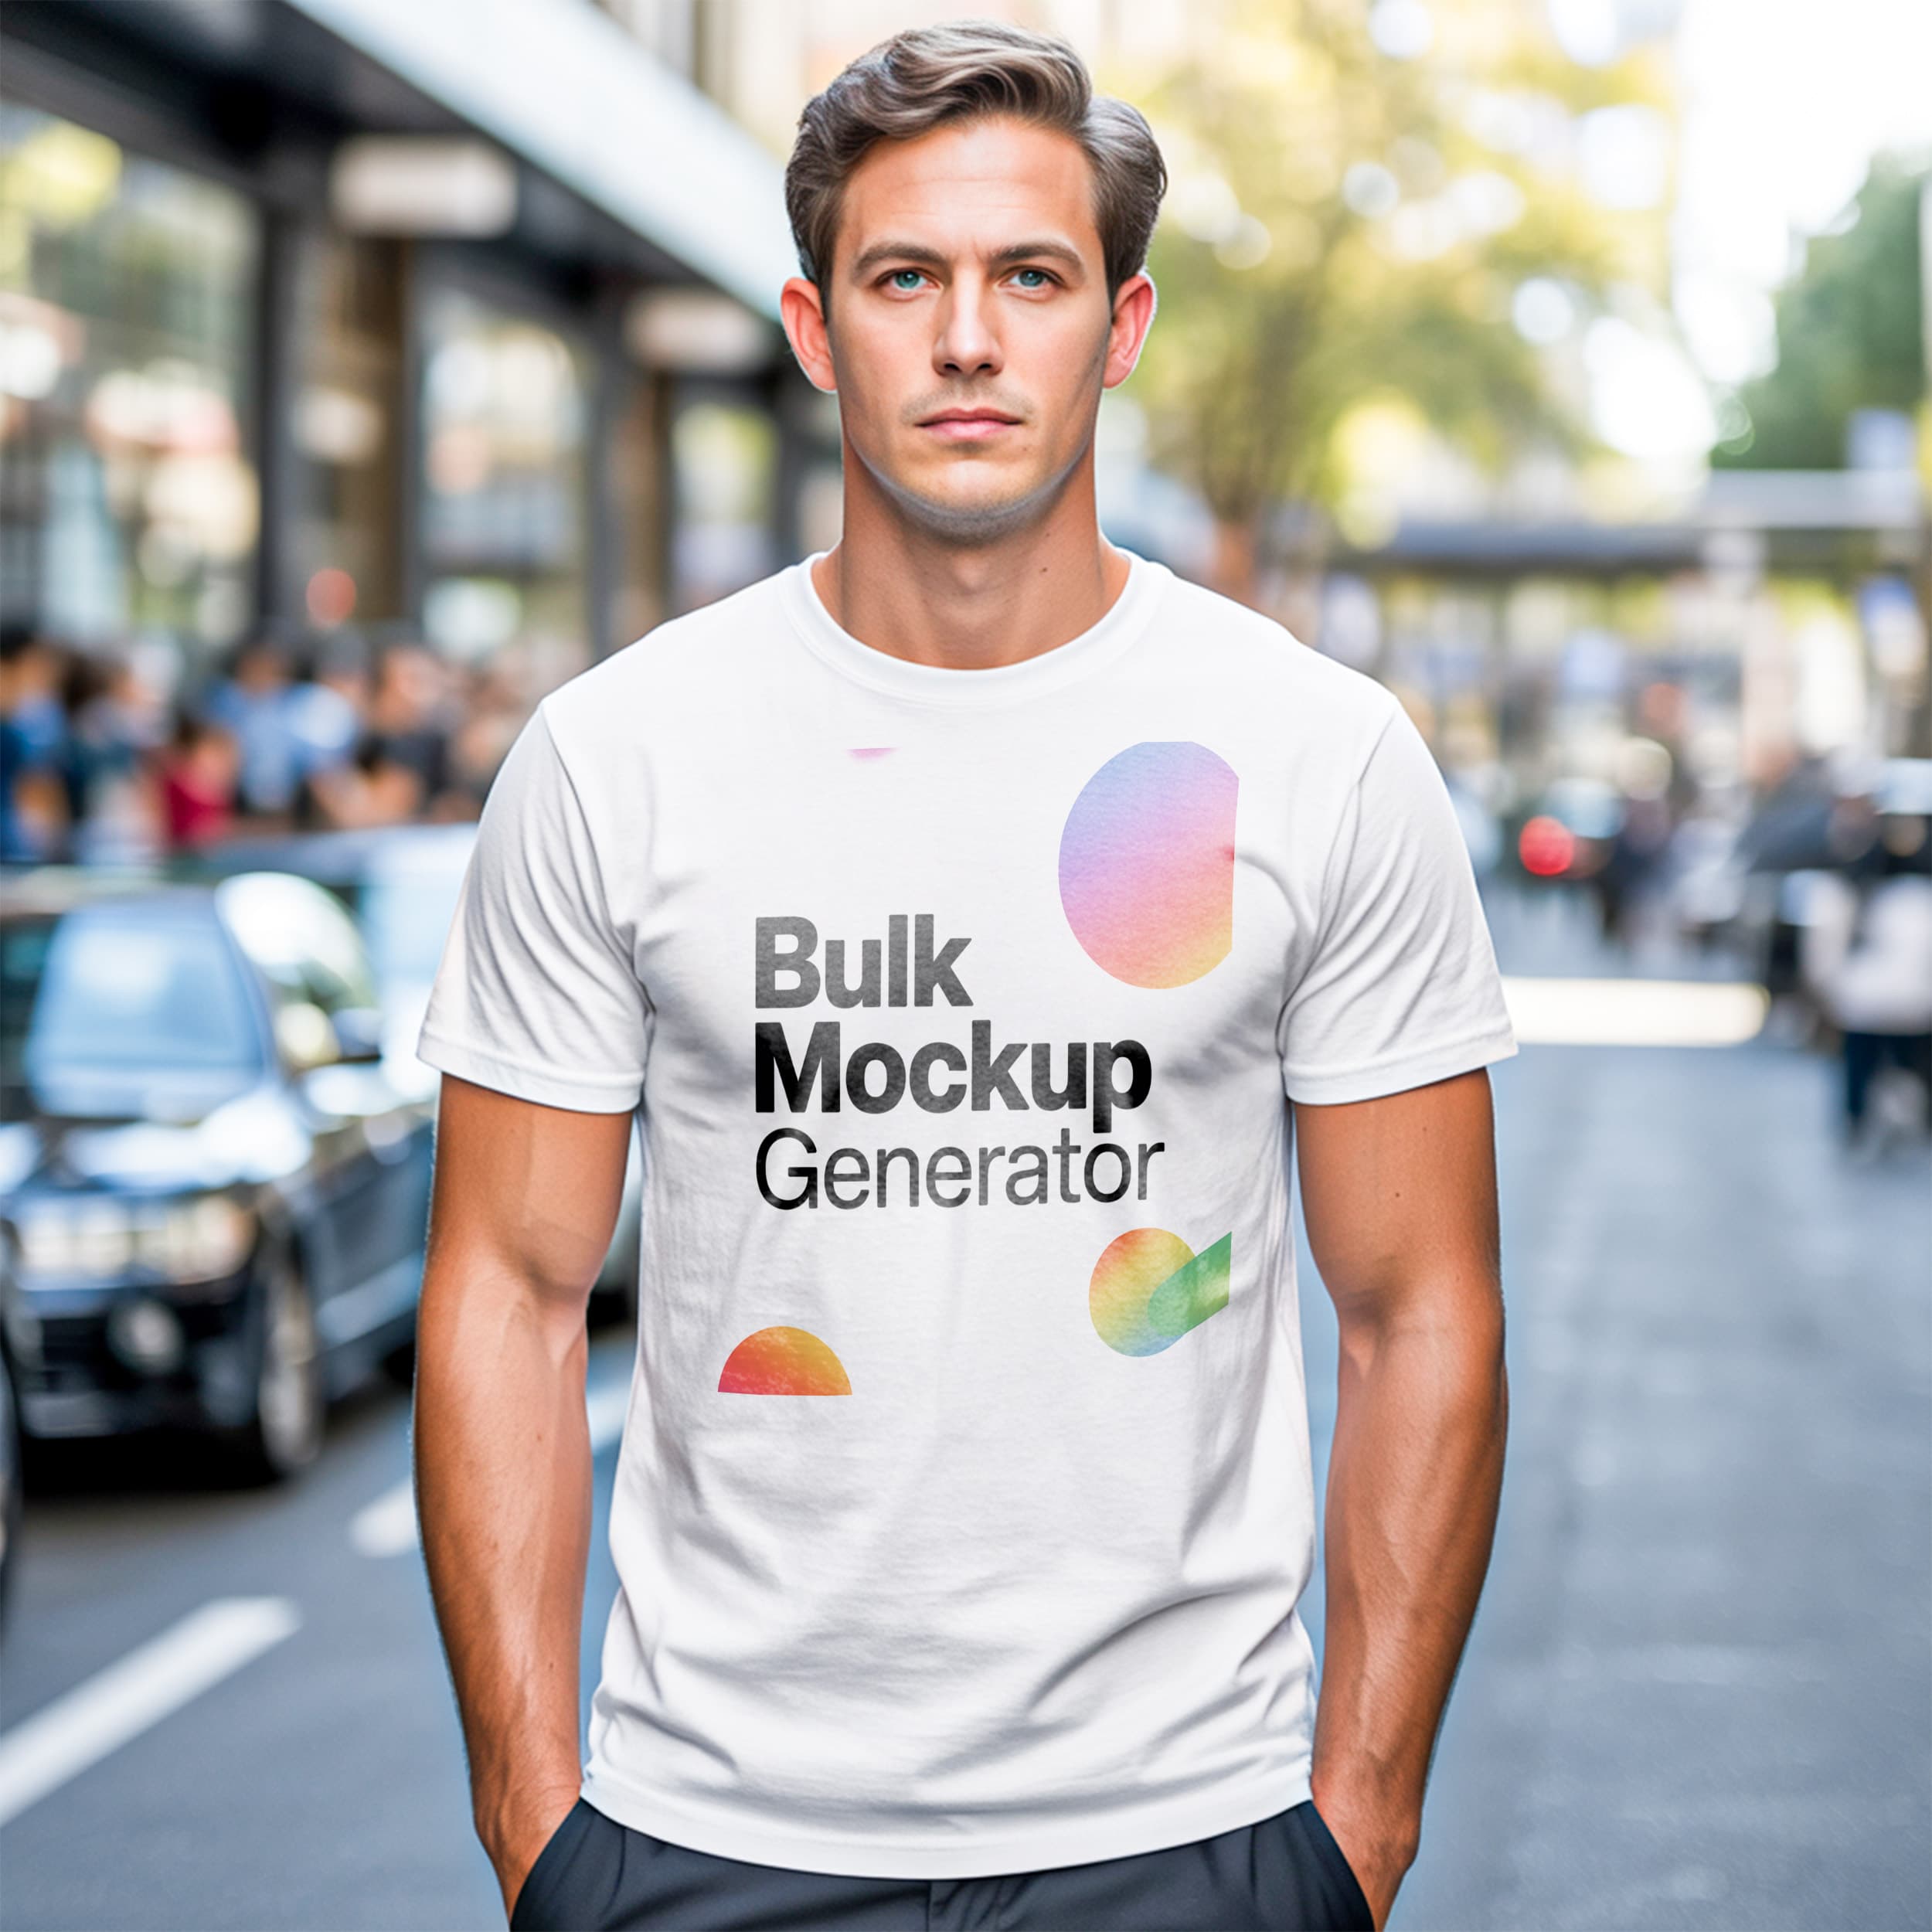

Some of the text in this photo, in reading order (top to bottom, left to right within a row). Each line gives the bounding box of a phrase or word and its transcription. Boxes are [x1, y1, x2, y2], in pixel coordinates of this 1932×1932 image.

[754, 913, 974, 1009] Bulk
[754, 1019, 1152, 1134] Mockup
[755, 1127, 1165, 1211] Generator
